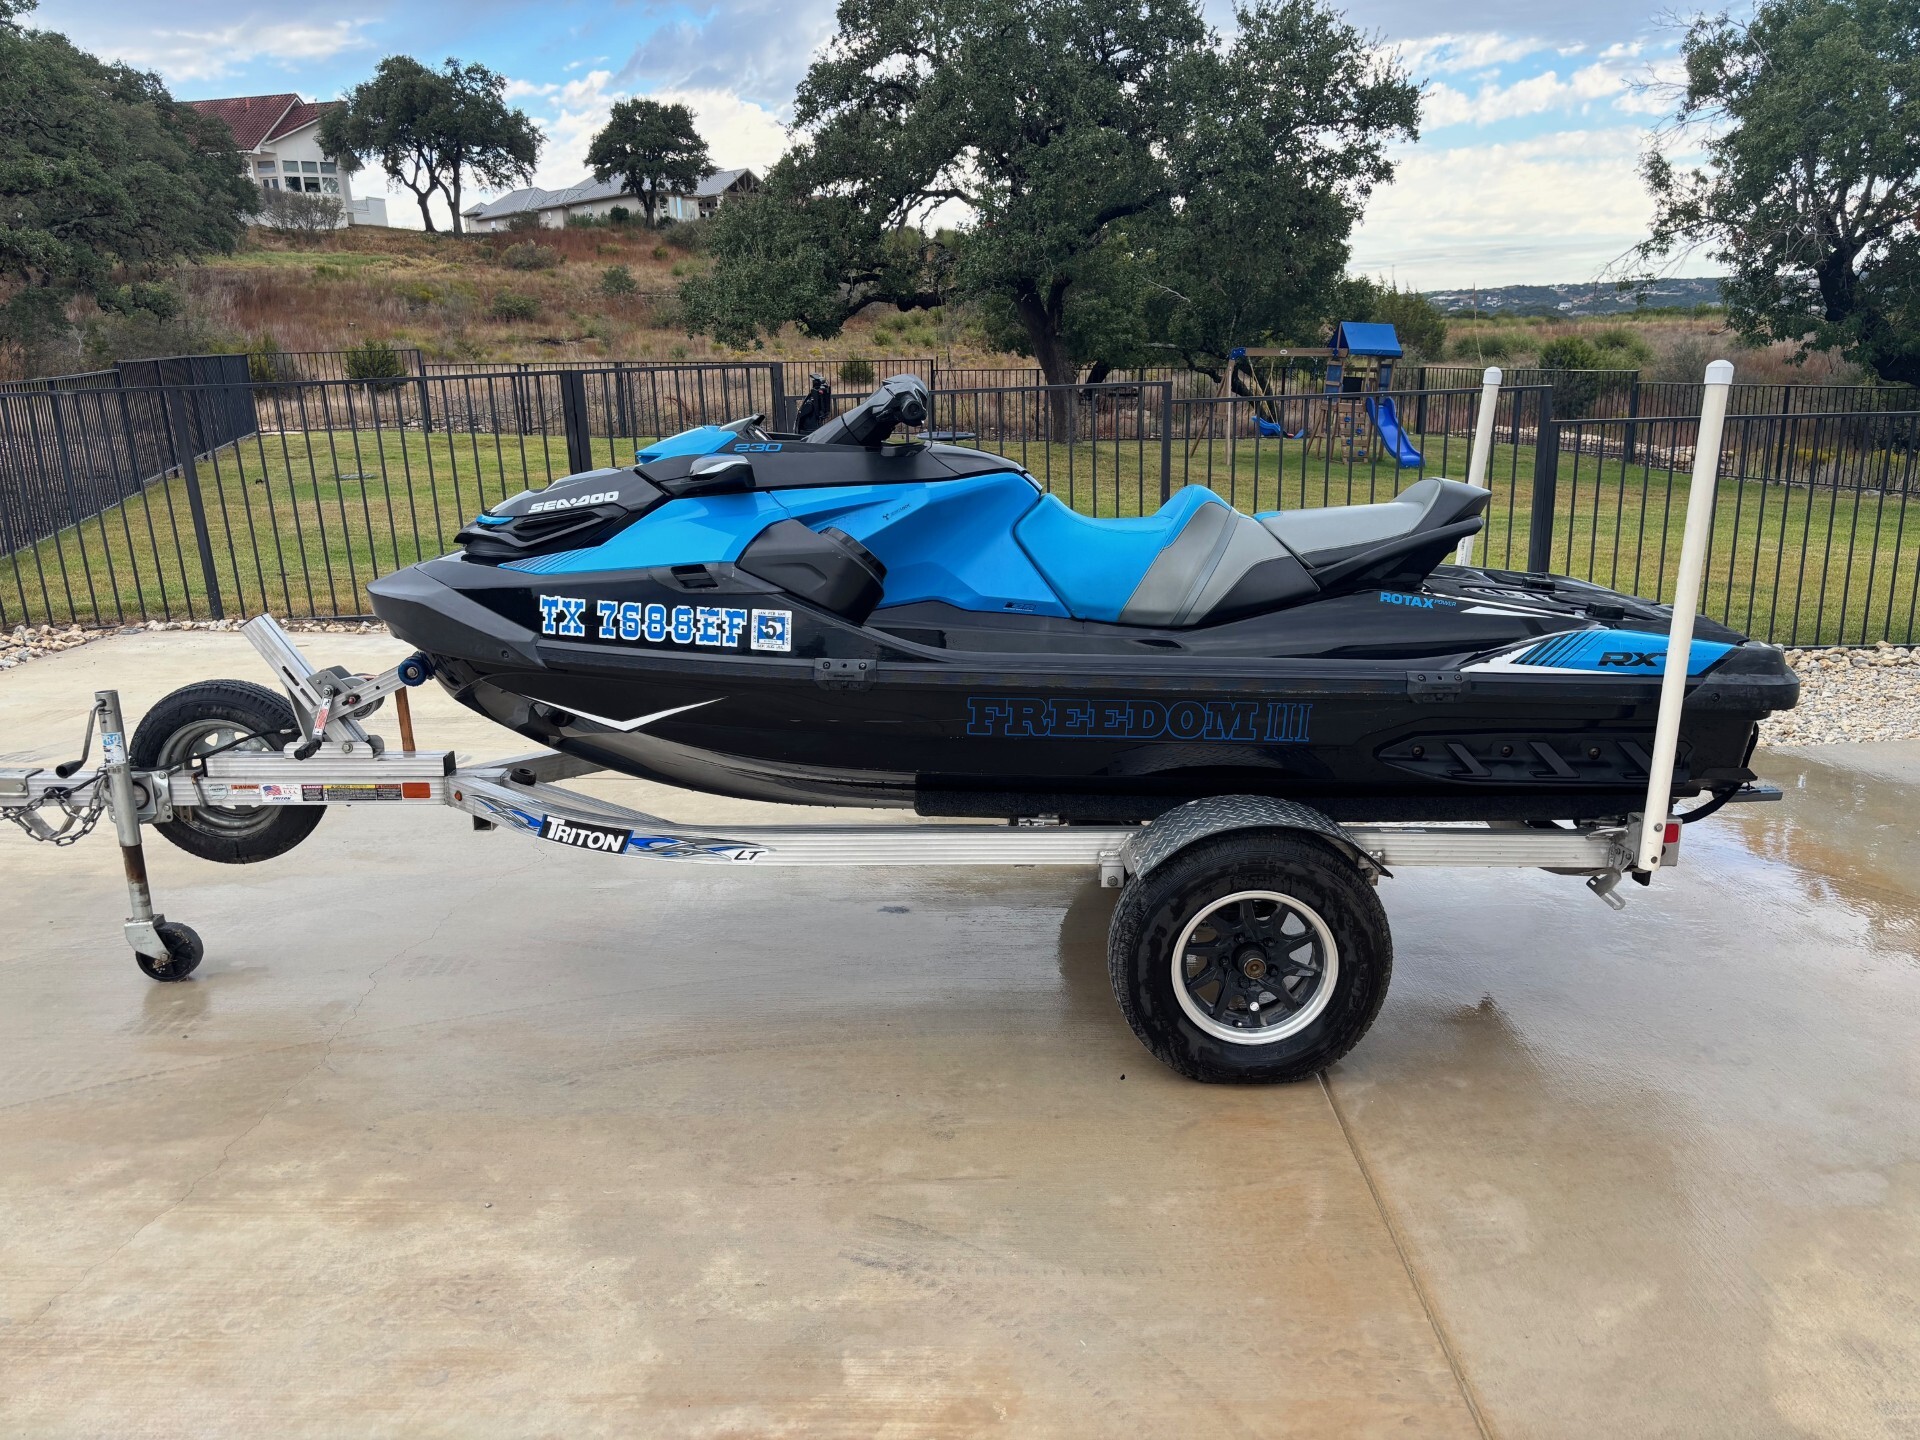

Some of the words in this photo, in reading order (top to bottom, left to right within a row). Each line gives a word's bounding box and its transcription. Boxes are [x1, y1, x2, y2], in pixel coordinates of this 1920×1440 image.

[733, 443, 783, 452] 230
[1380, 592, 1433, 608] ROTAX
[1434, 599, 1457, 607] POWER
[539, 595, 586, 637] TX
[597, 600, 747, 647] 7688EF
[765, 617, 778, 640] 5
[967, 697, 1258, 741] FREEDOM
[1264, 702, 1313, 742] III
[547, 816, 624, 852] TRITON
[734, 850, 766, 860] LT
